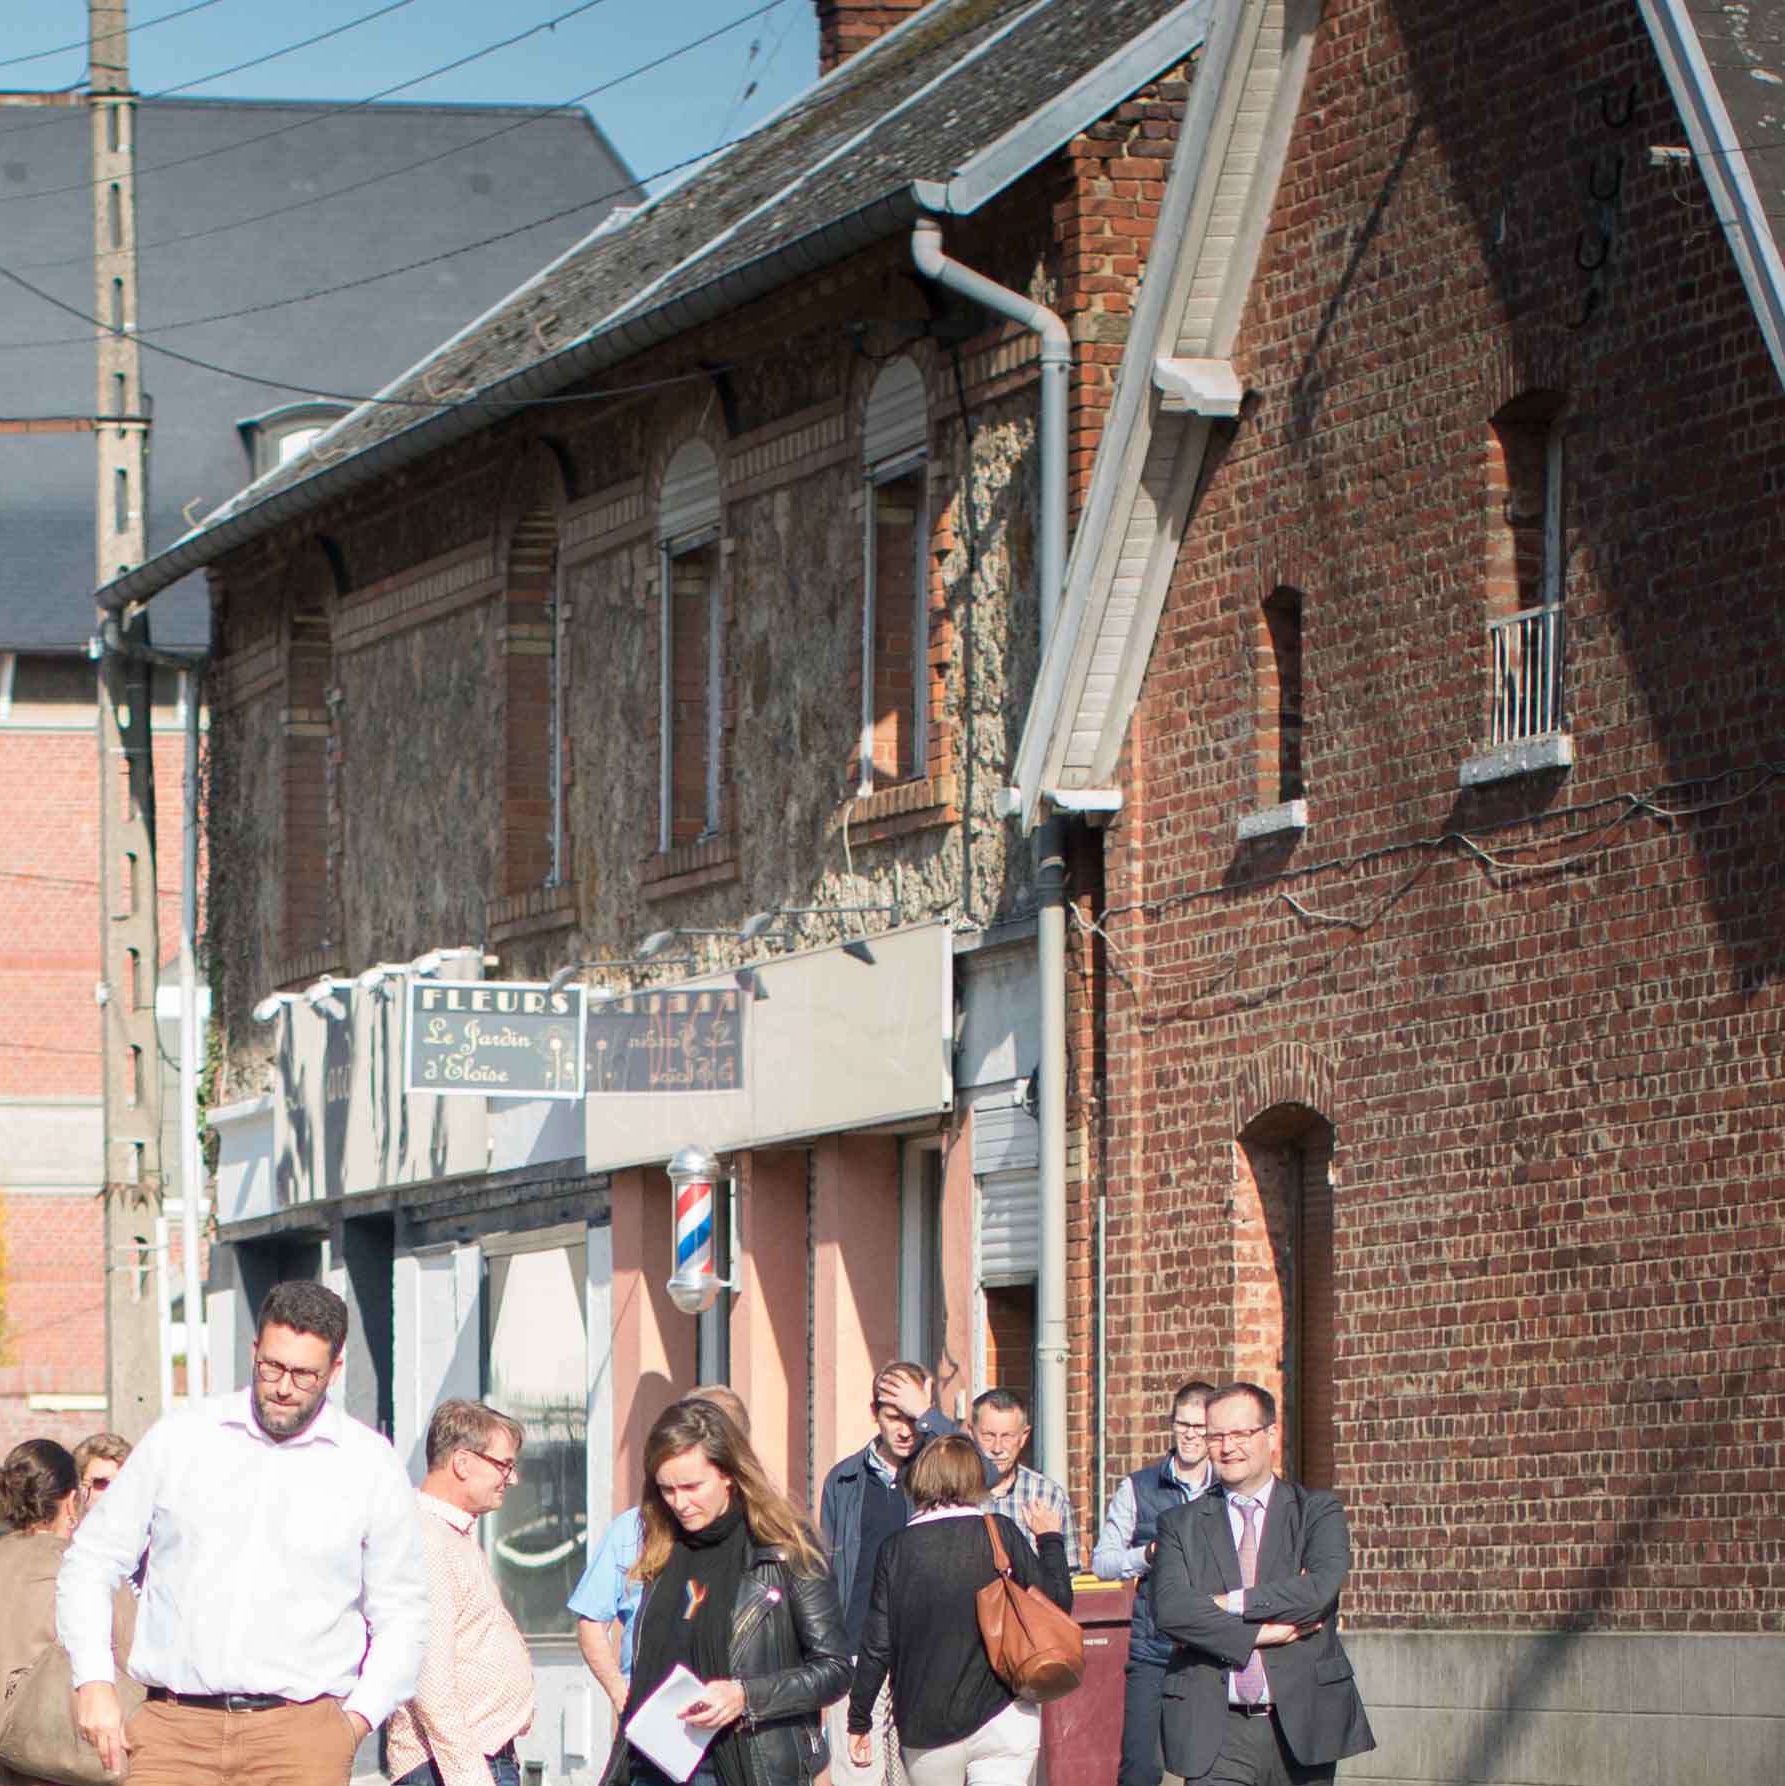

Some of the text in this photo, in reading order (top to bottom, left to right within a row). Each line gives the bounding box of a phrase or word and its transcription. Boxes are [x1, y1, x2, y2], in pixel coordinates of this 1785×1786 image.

[422, 988, 569, 1015] FLEURS
[423, 1017, 532, 1056] Le Jardin
